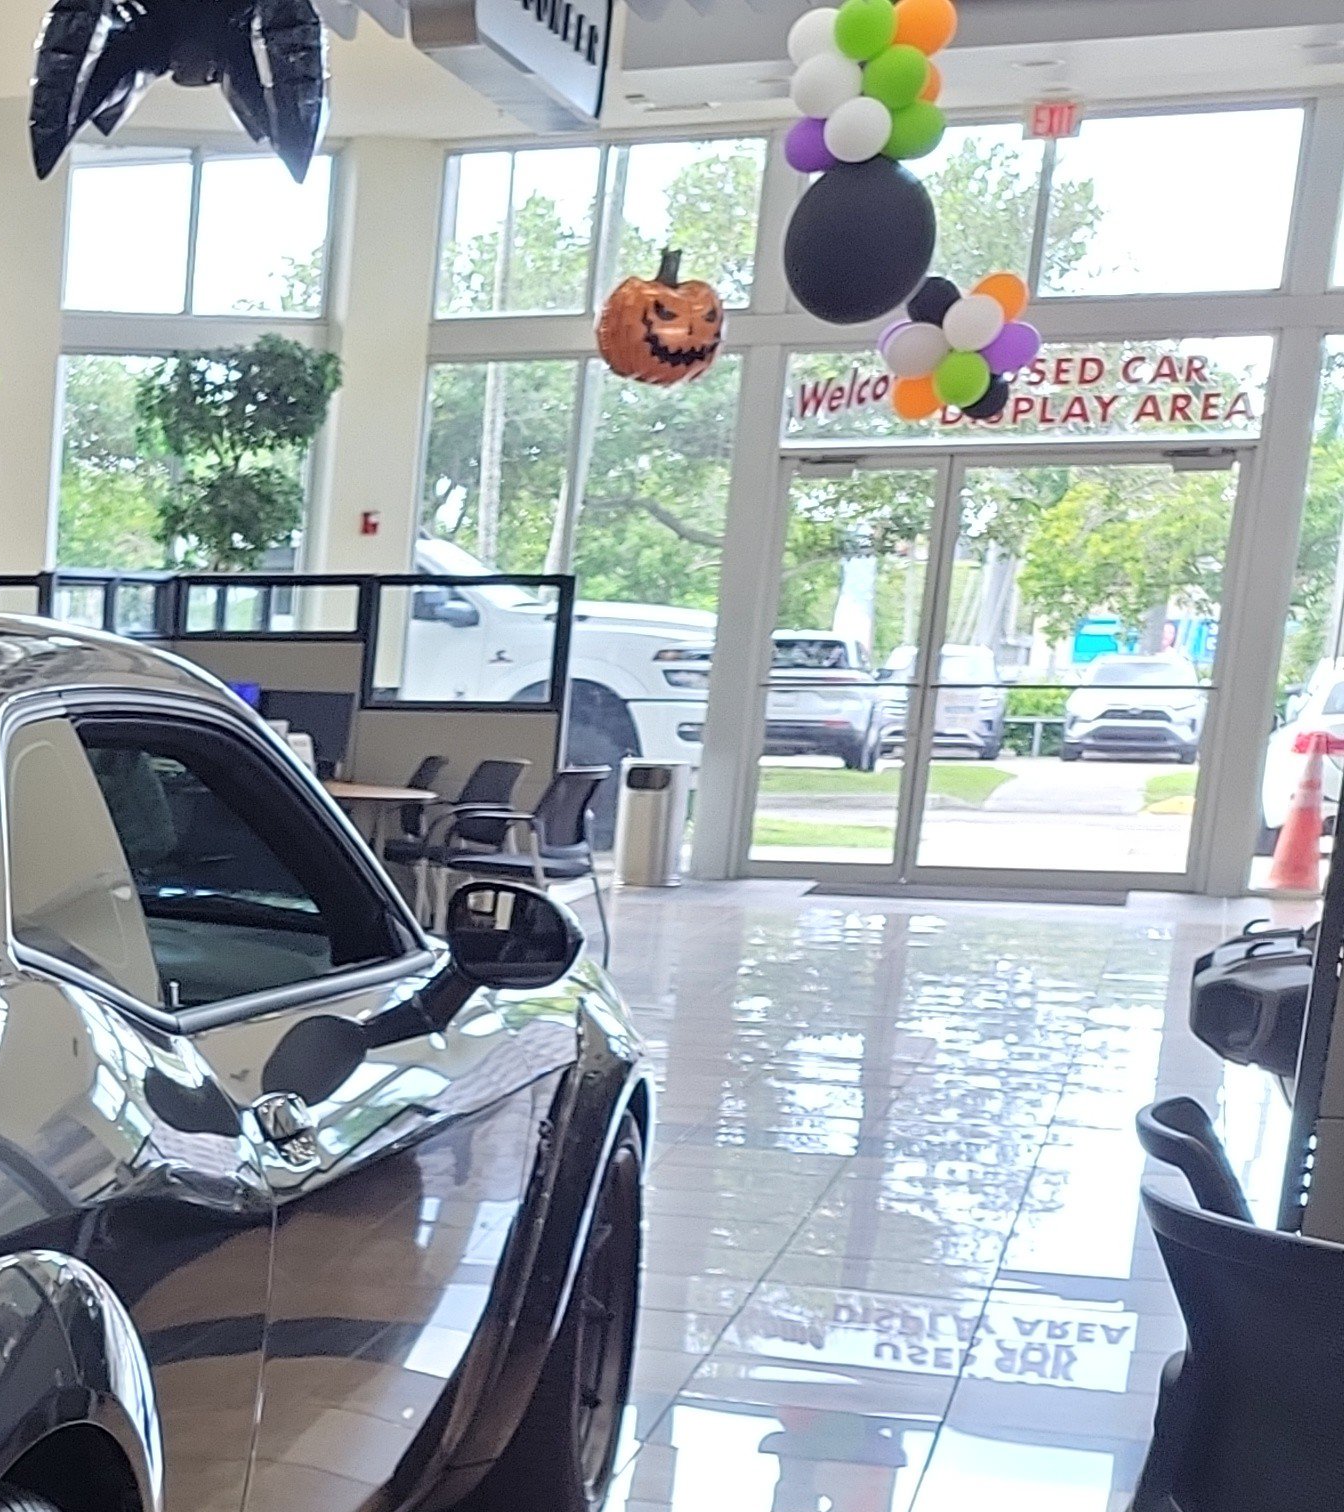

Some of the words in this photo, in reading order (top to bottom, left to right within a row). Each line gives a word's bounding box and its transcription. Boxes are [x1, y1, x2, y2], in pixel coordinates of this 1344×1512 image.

[1006, 357, 1105, 386] SED
[1122, 355, 1209, 383] CAR
[798, 368, 898, 419] Welco
[1132, 391, 1256, 423] AREA
